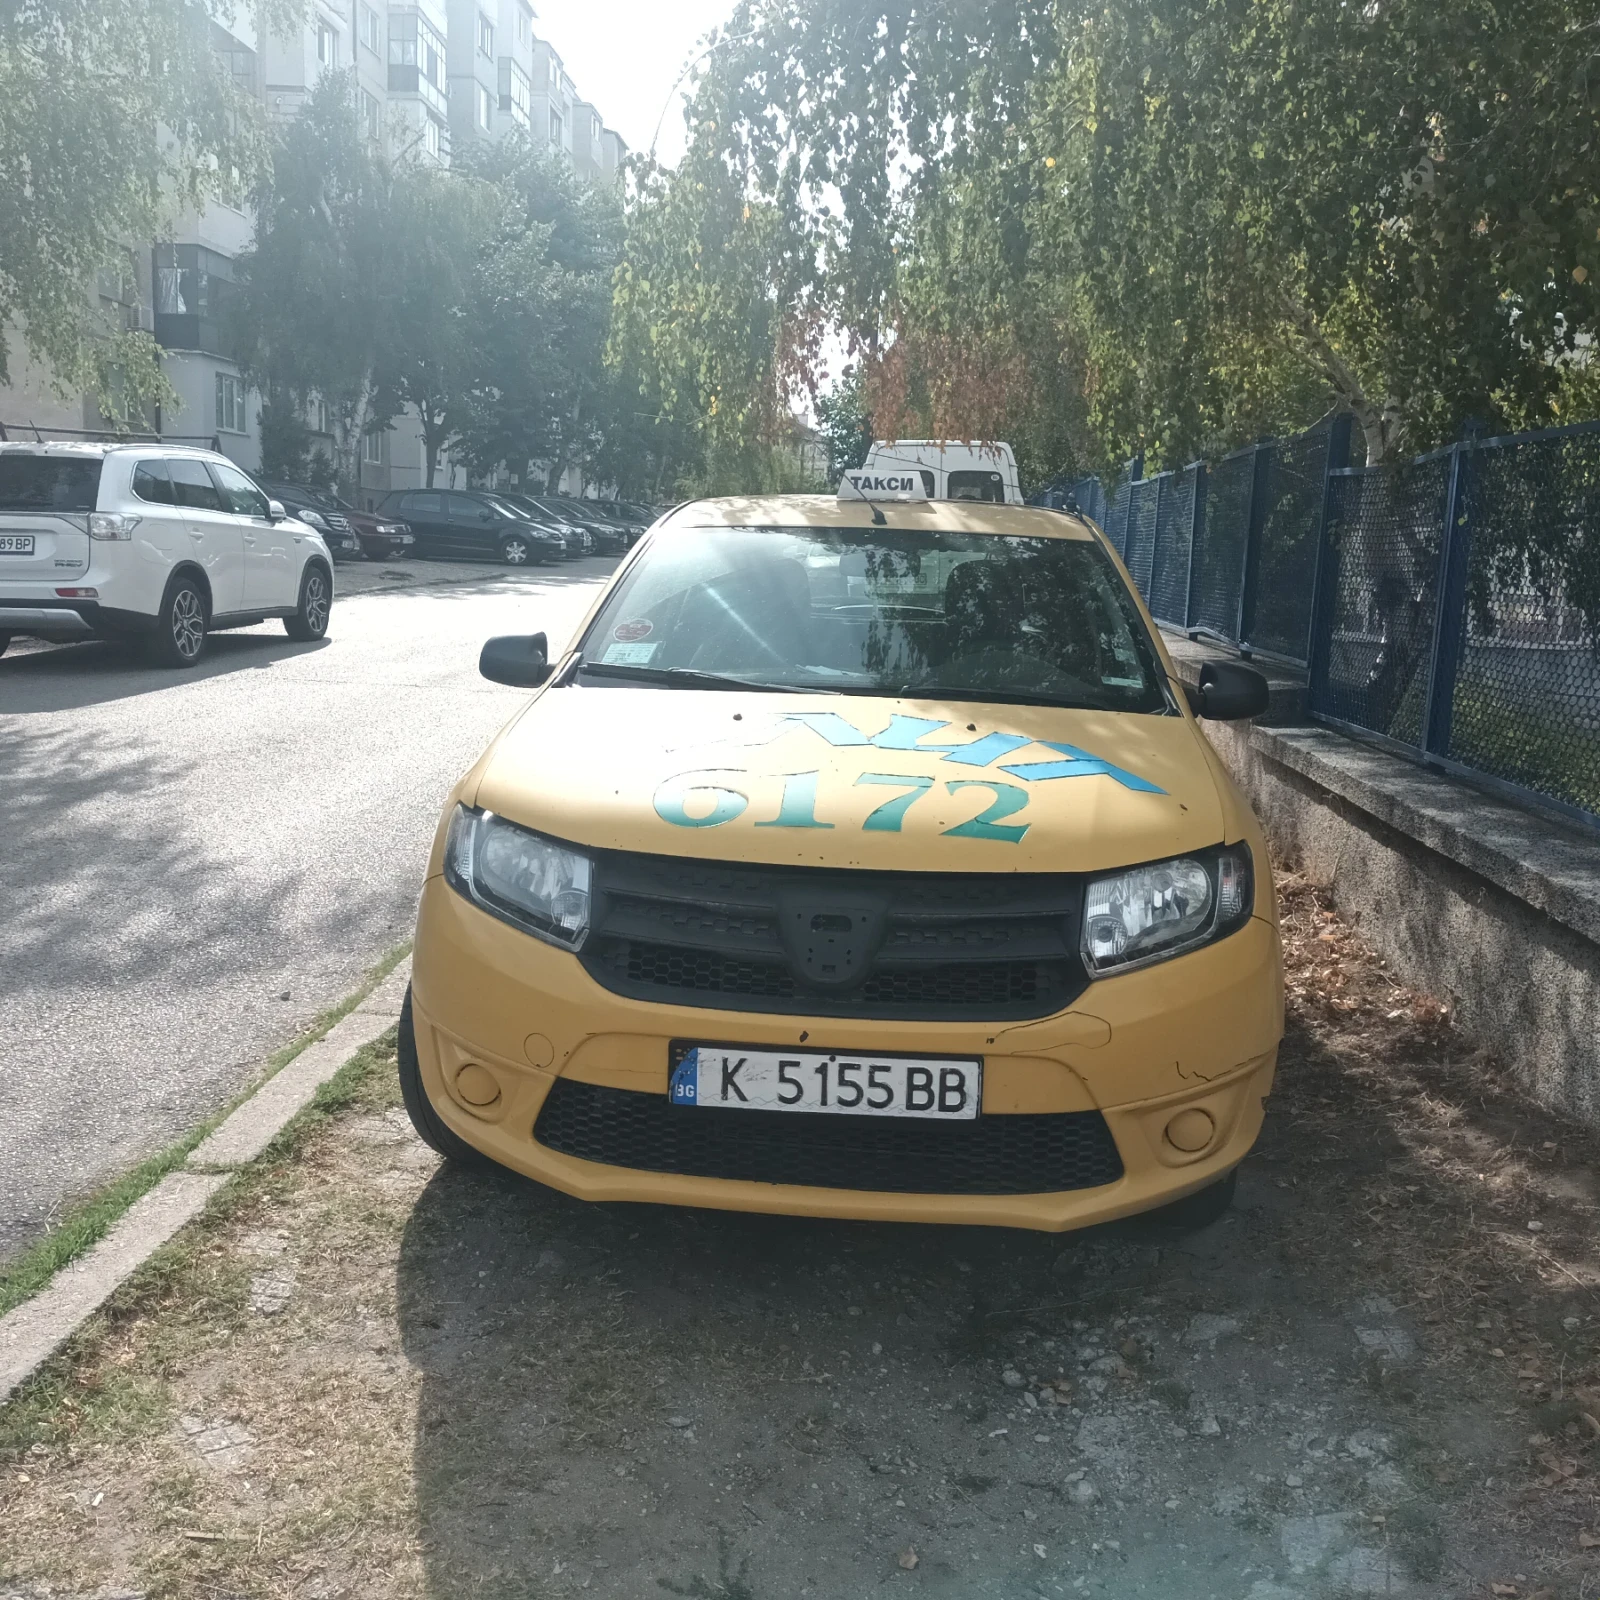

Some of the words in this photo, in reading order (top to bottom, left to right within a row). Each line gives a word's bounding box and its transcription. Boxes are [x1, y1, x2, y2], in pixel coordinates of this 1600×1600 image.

[851, 476, 914, 491] ТАКСИ
[653, 769, 1031, 844] 6172
[720, 1057, 748, 1102] K
[778, 1060, 894, 1108] 5155
[906, 1067, 966, 1112] BB
